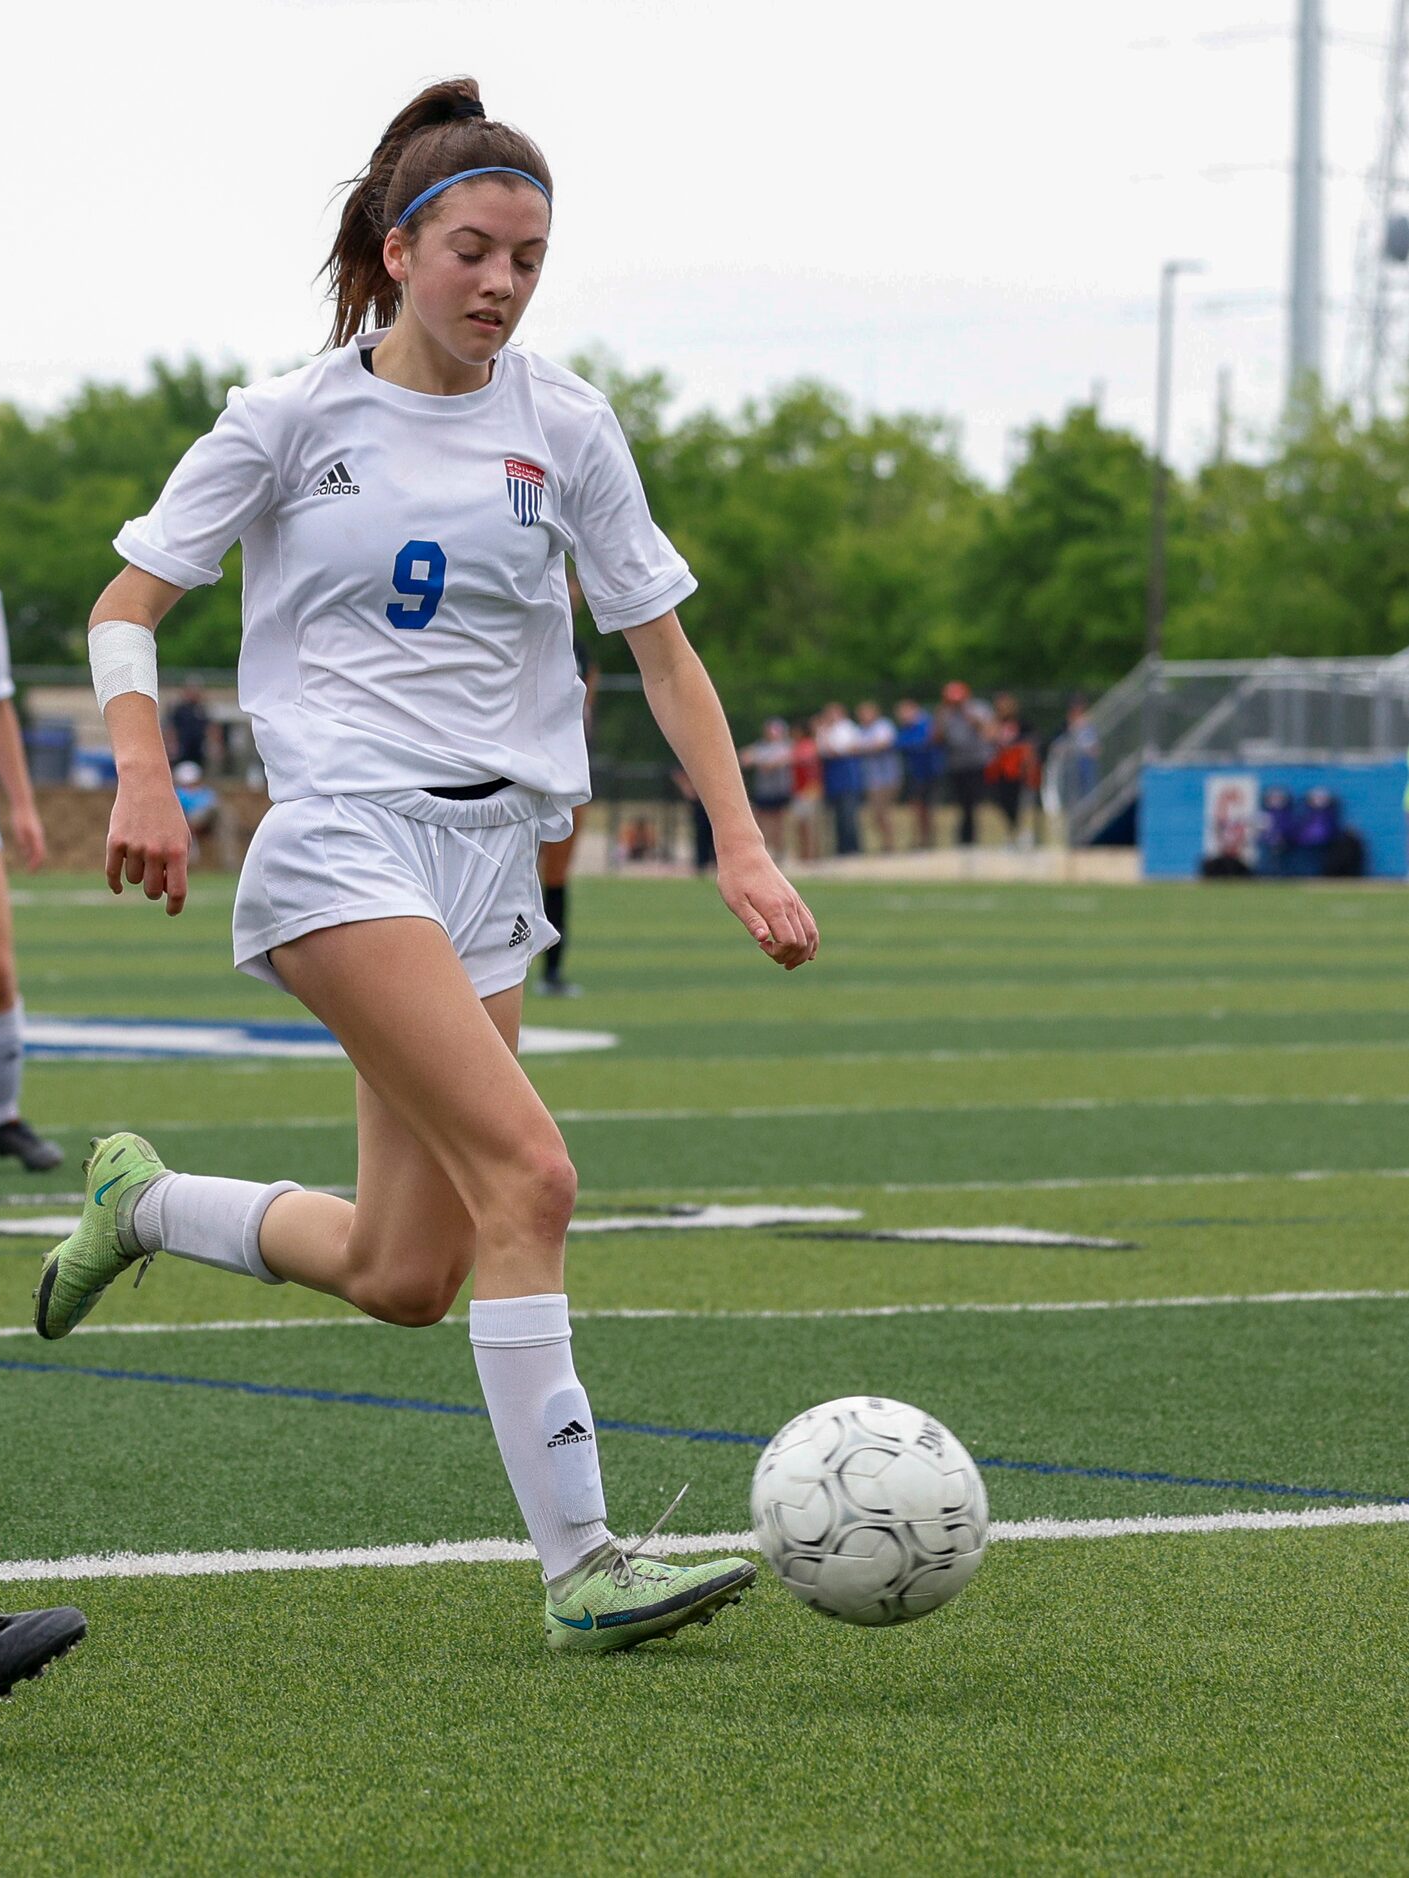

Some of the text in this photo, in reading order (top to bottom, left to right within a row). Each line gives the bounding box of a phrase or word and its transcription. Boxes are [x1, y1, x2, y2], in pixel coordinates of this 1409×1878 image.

[312, 482, 361, 496] adidas
[386, 540, 447, 629] 9
[547, 1433, 592, 1448] adidas
